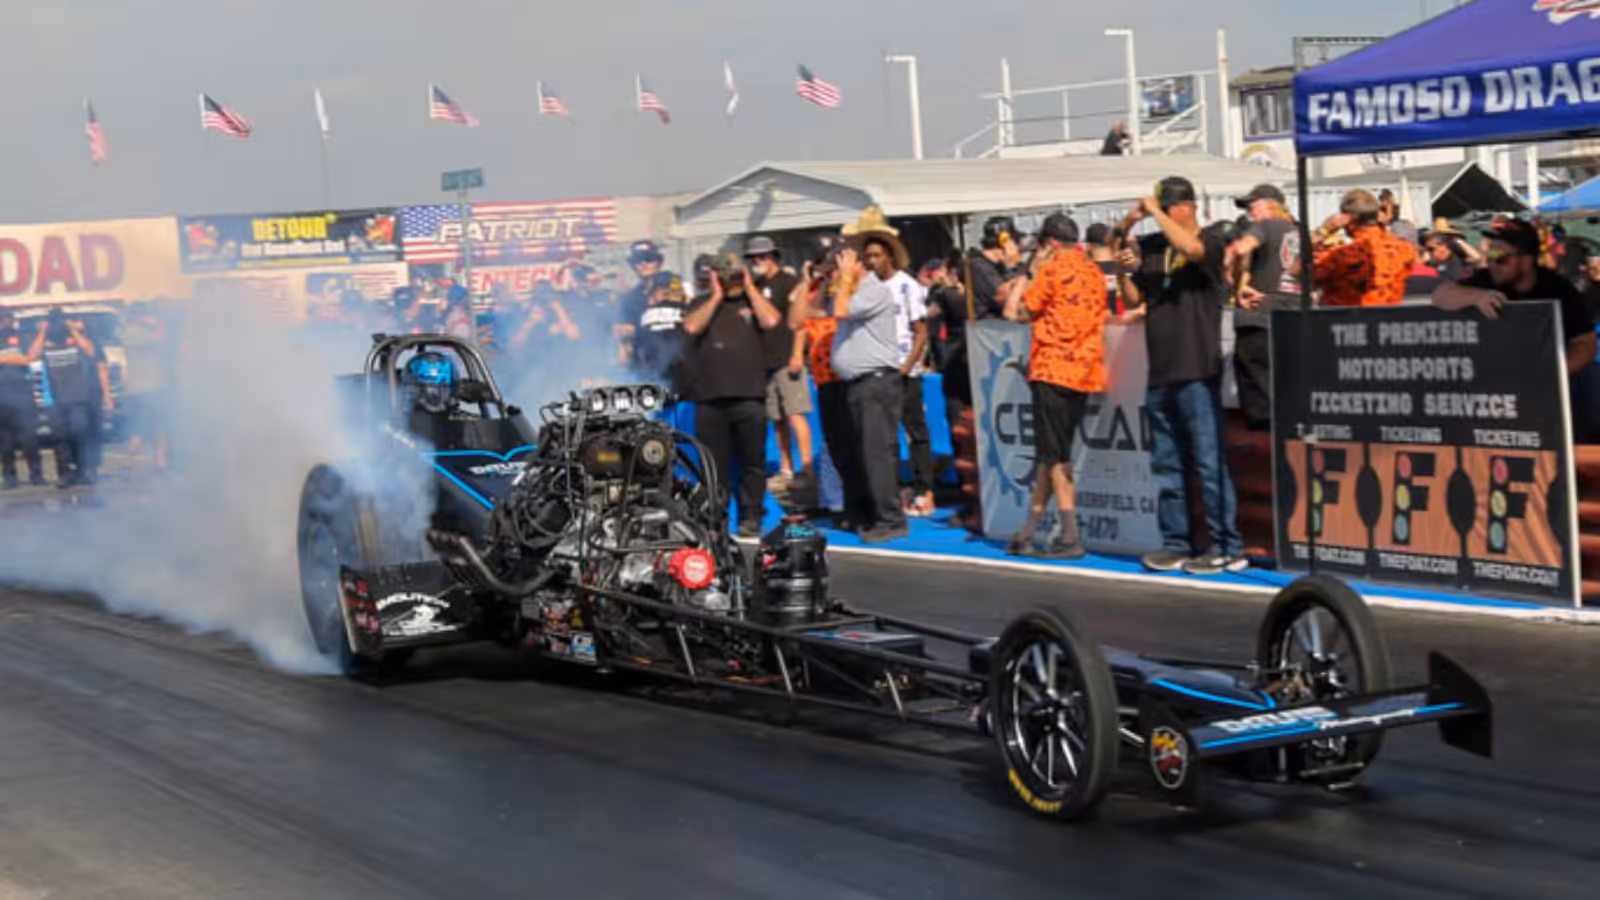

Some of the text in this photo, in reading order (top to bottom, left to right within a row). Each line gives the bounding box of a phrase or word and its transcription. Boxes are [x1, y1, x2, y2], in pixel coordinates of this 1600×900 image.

[1308, 76, 1471, 134] FAMOSO
[252, 217, 326, 240] DETOUR
[439, 217, 582, 244] PATRIOT
[1331, 320, 1479, 346] THE PREMIERE
[1338, 358, 1474, 380] MOTORSPORTS
[1311, 391, 1518, 418] TICKETING SERVICE
[1473, 428, 1541, 448] TICKETING
